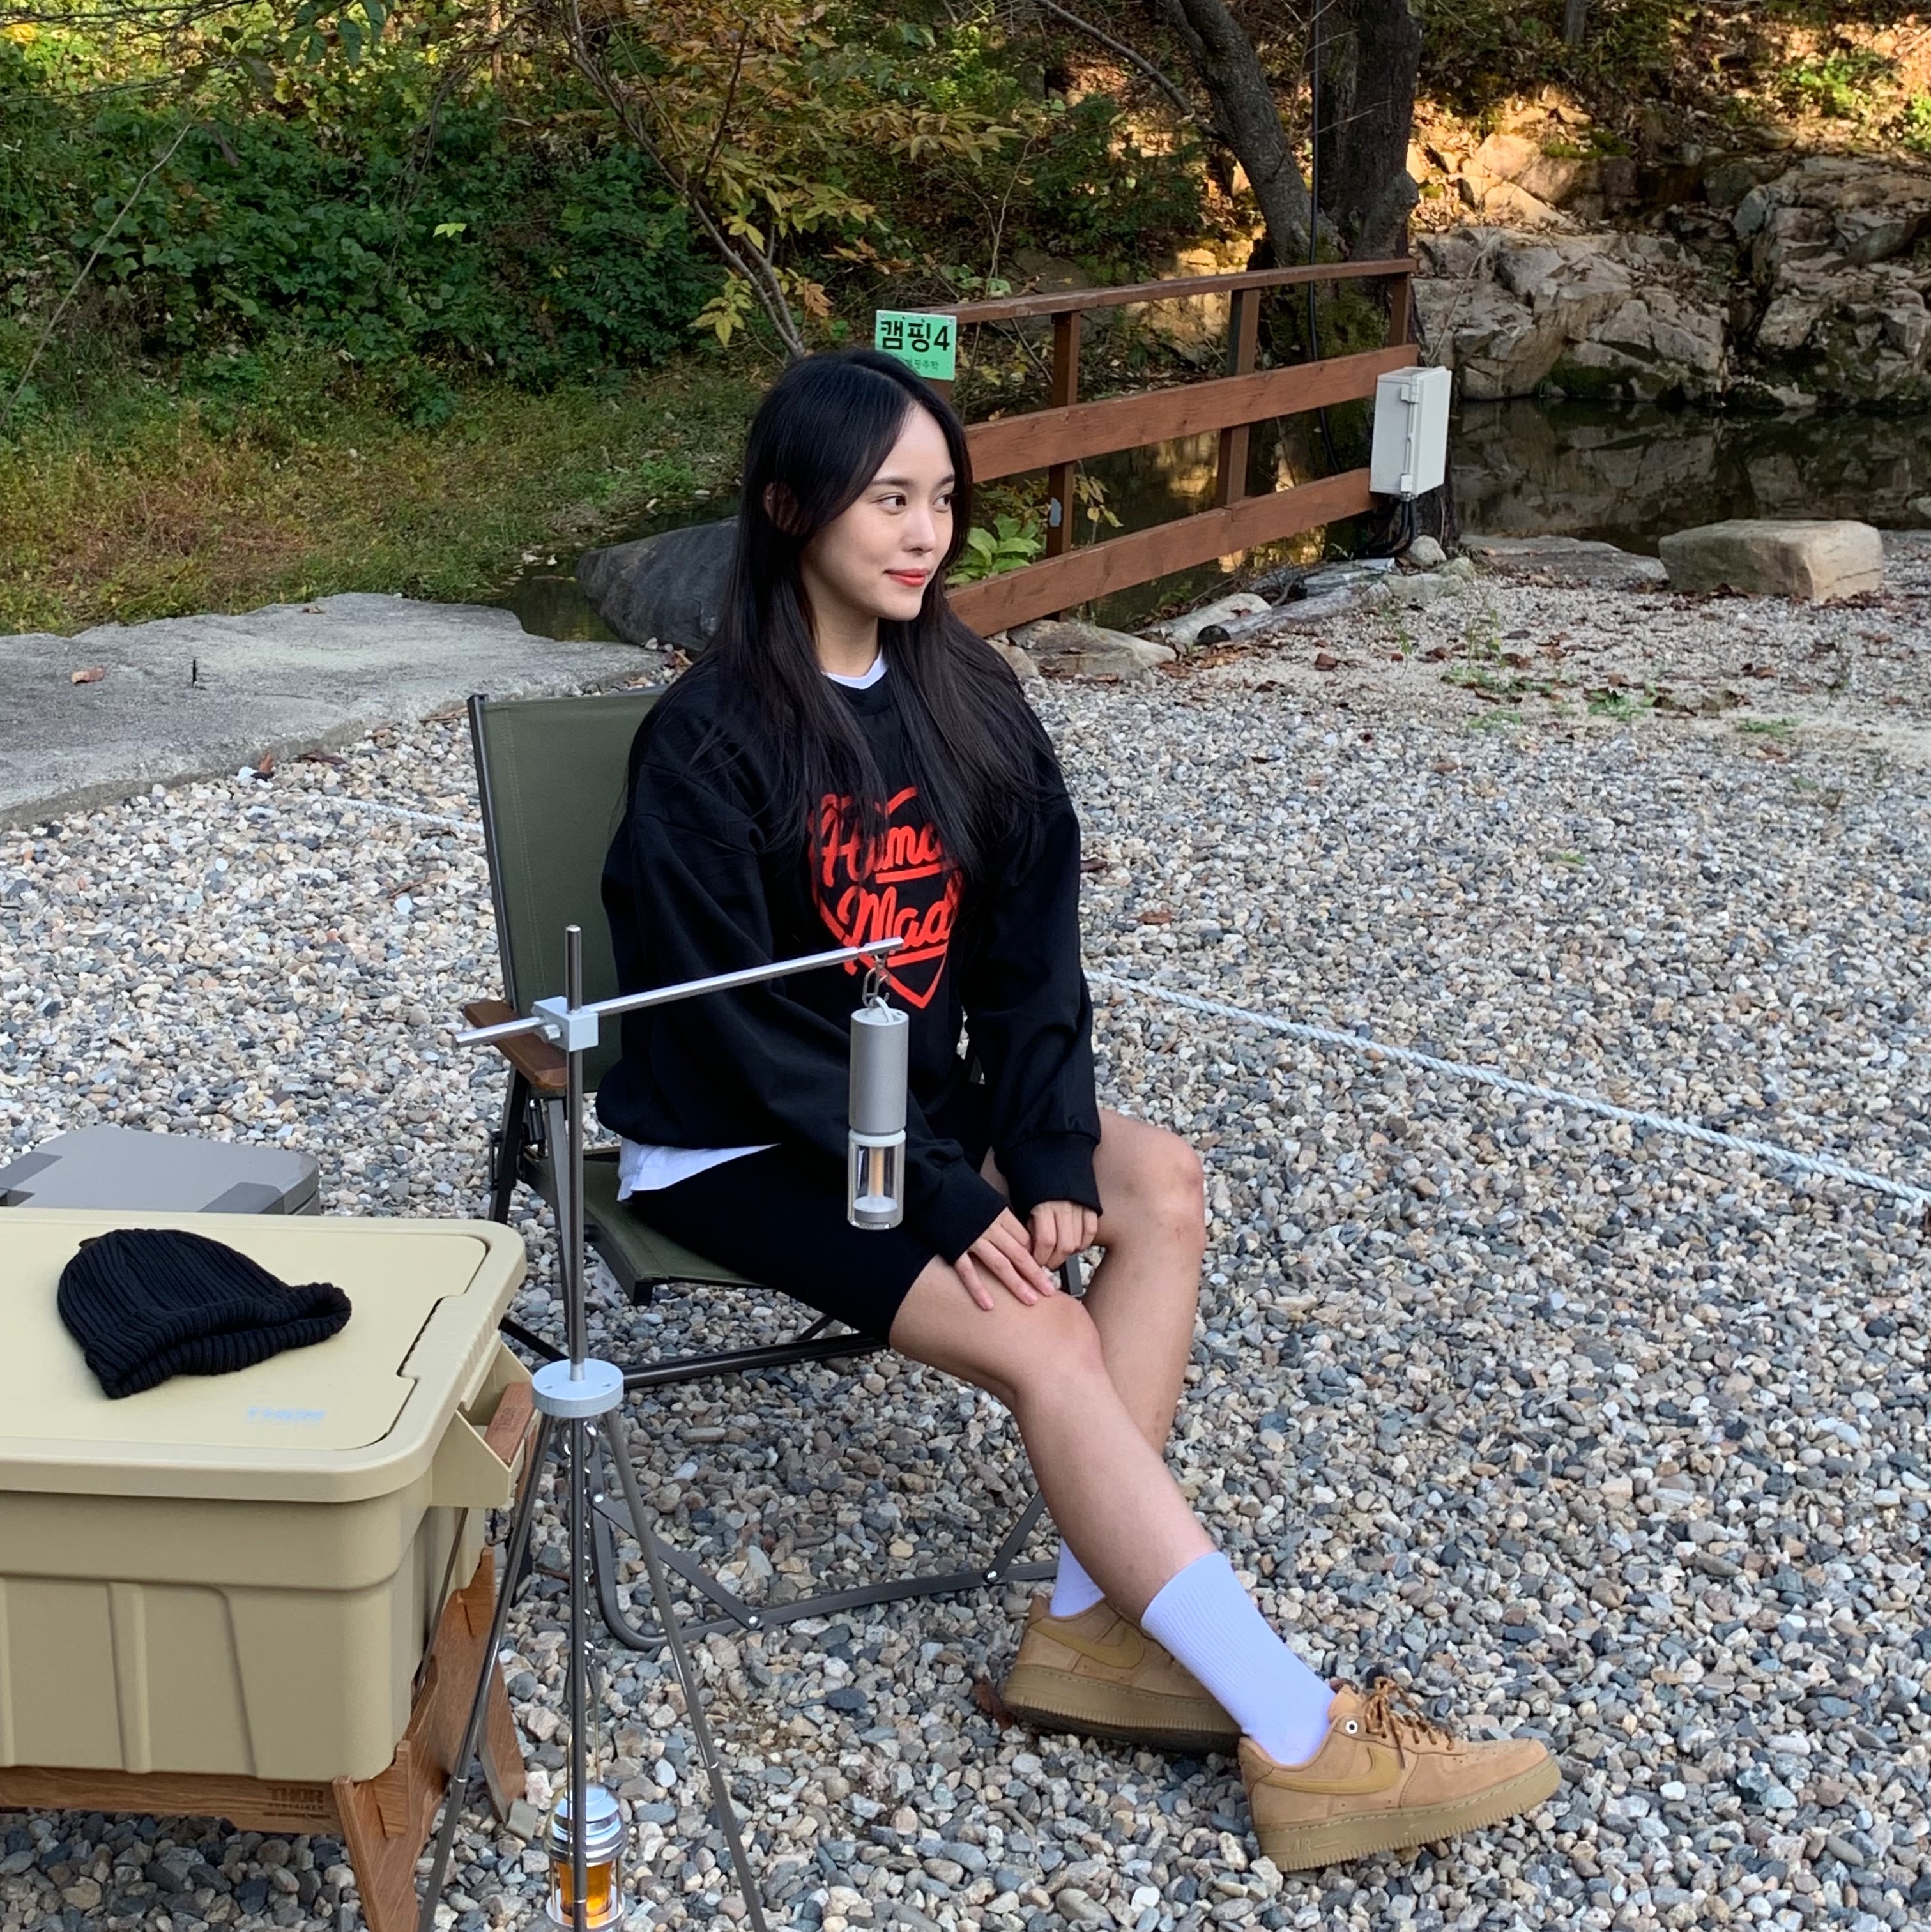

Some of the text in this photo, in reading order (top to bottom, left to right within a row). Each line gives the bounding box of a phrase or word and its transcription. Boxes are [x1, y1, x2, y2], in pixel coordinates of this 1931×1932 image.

[880, 321, 950, 353] 캠핑4
[820, 793, 945, 888] Huma
[836, 874, 959, 975] Mad
[1291, 1837, 1311, 1853] AIR
